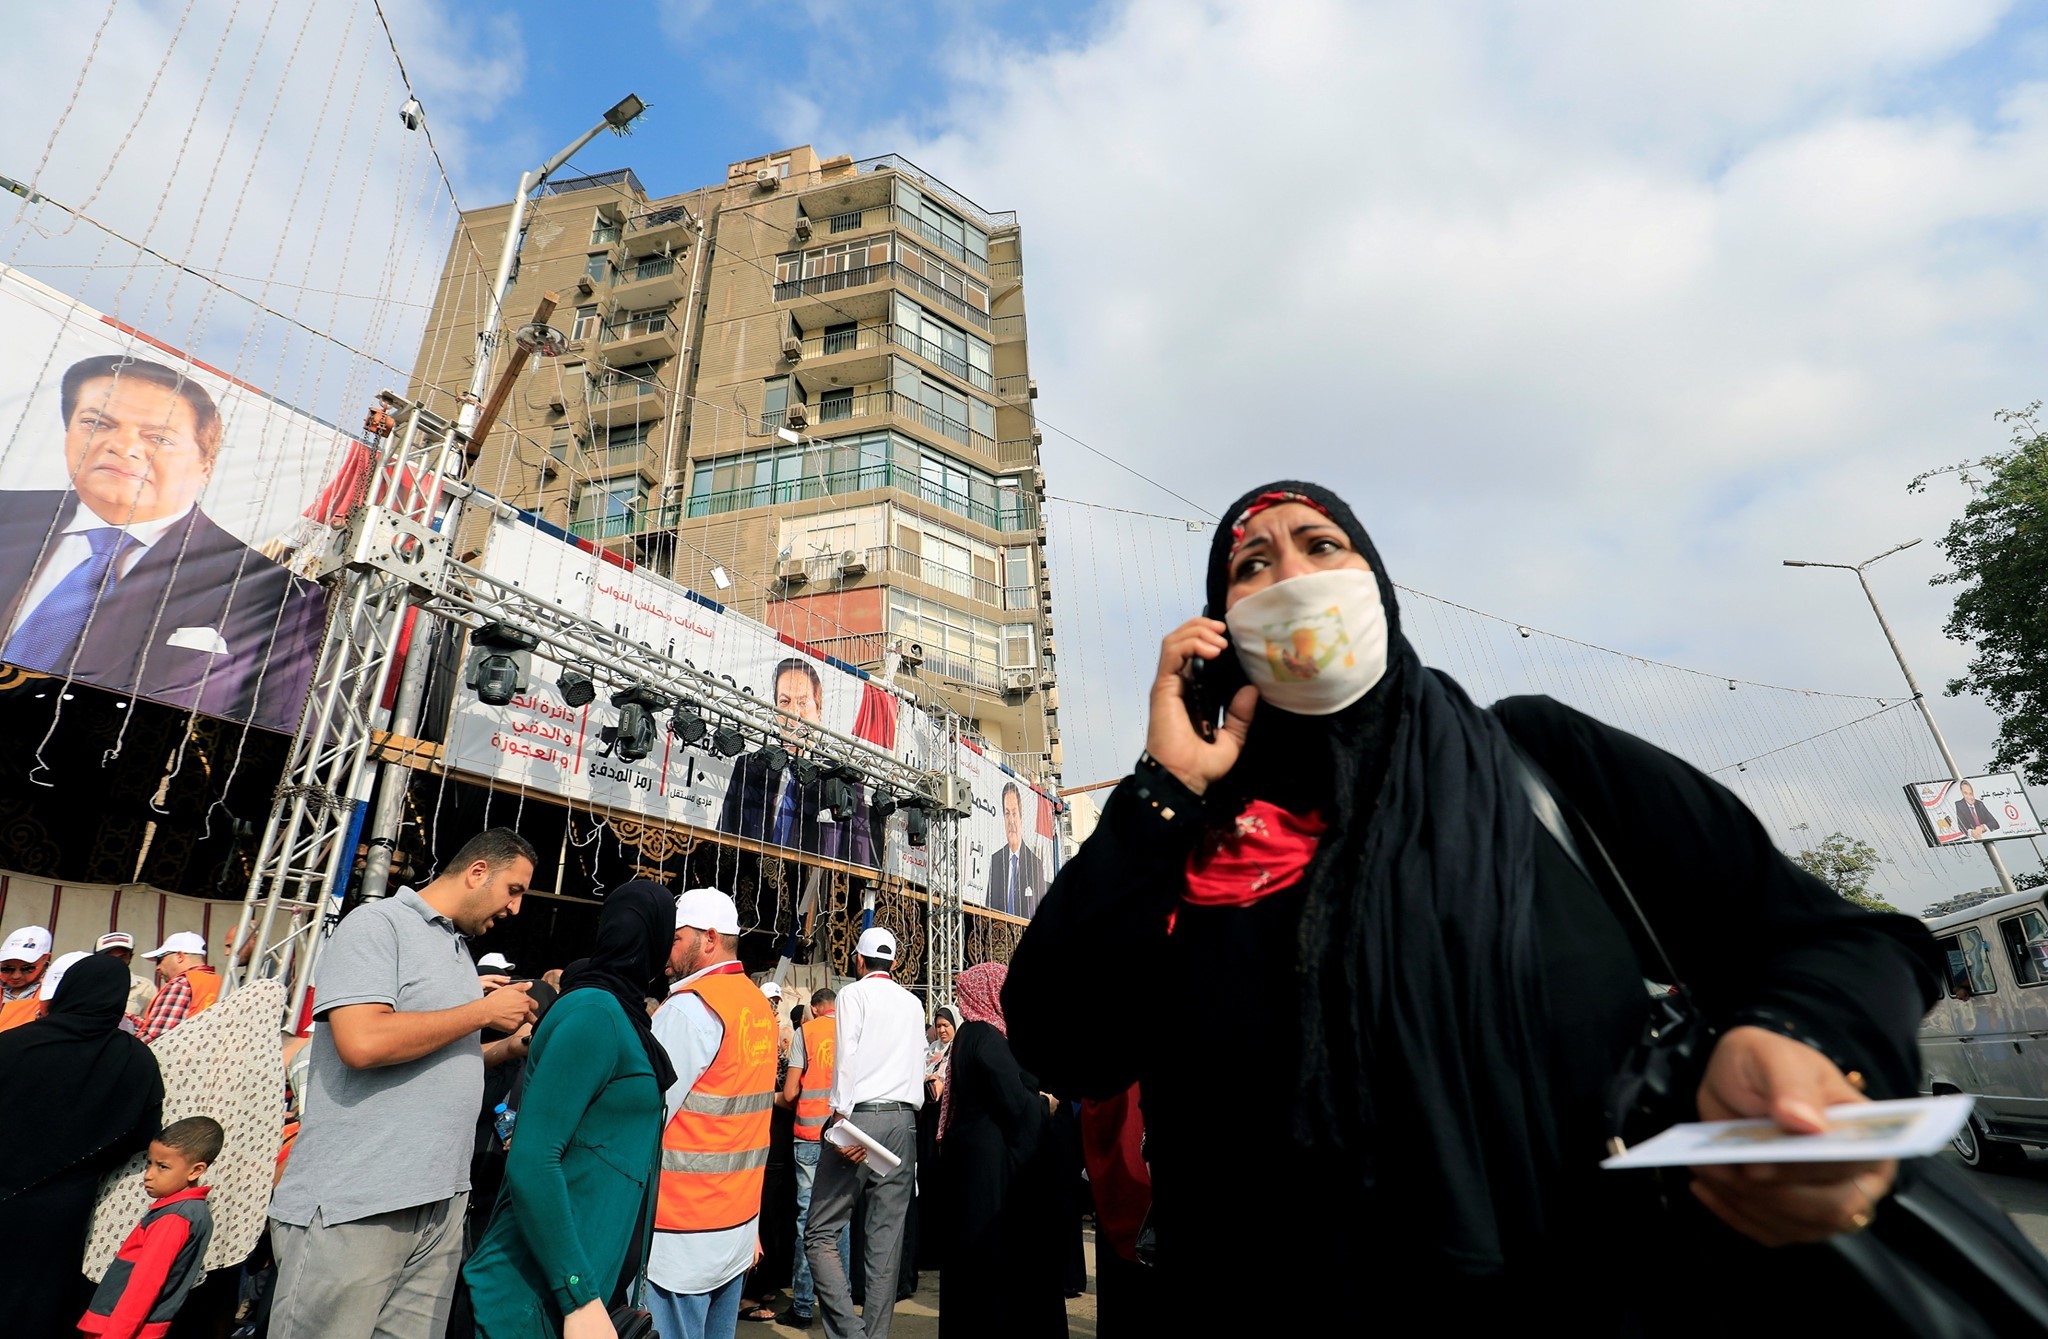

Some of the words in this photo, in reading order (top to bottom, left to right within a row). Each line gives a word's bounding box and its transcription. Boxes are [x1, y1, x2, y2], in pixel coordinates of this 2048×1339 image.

[597, 582, 633, 605] النواب
[634, 599, 672, 622] مجلس
[674, 615, 715, 639] انتخابات
[510, 695, 538, 711] الج
[540, 700, 575, 723] دائرة
[512, 720, 560, 741] الدقي
[563, 734, 571, 747] و
[490, 732, 557, 763] العجوزة
[560, 756, 569, 769] و
[588, 762, 633, 783] المدفع
[633, 769, 653, 792] رمز
[669, 789, 695, 804] مستقل
